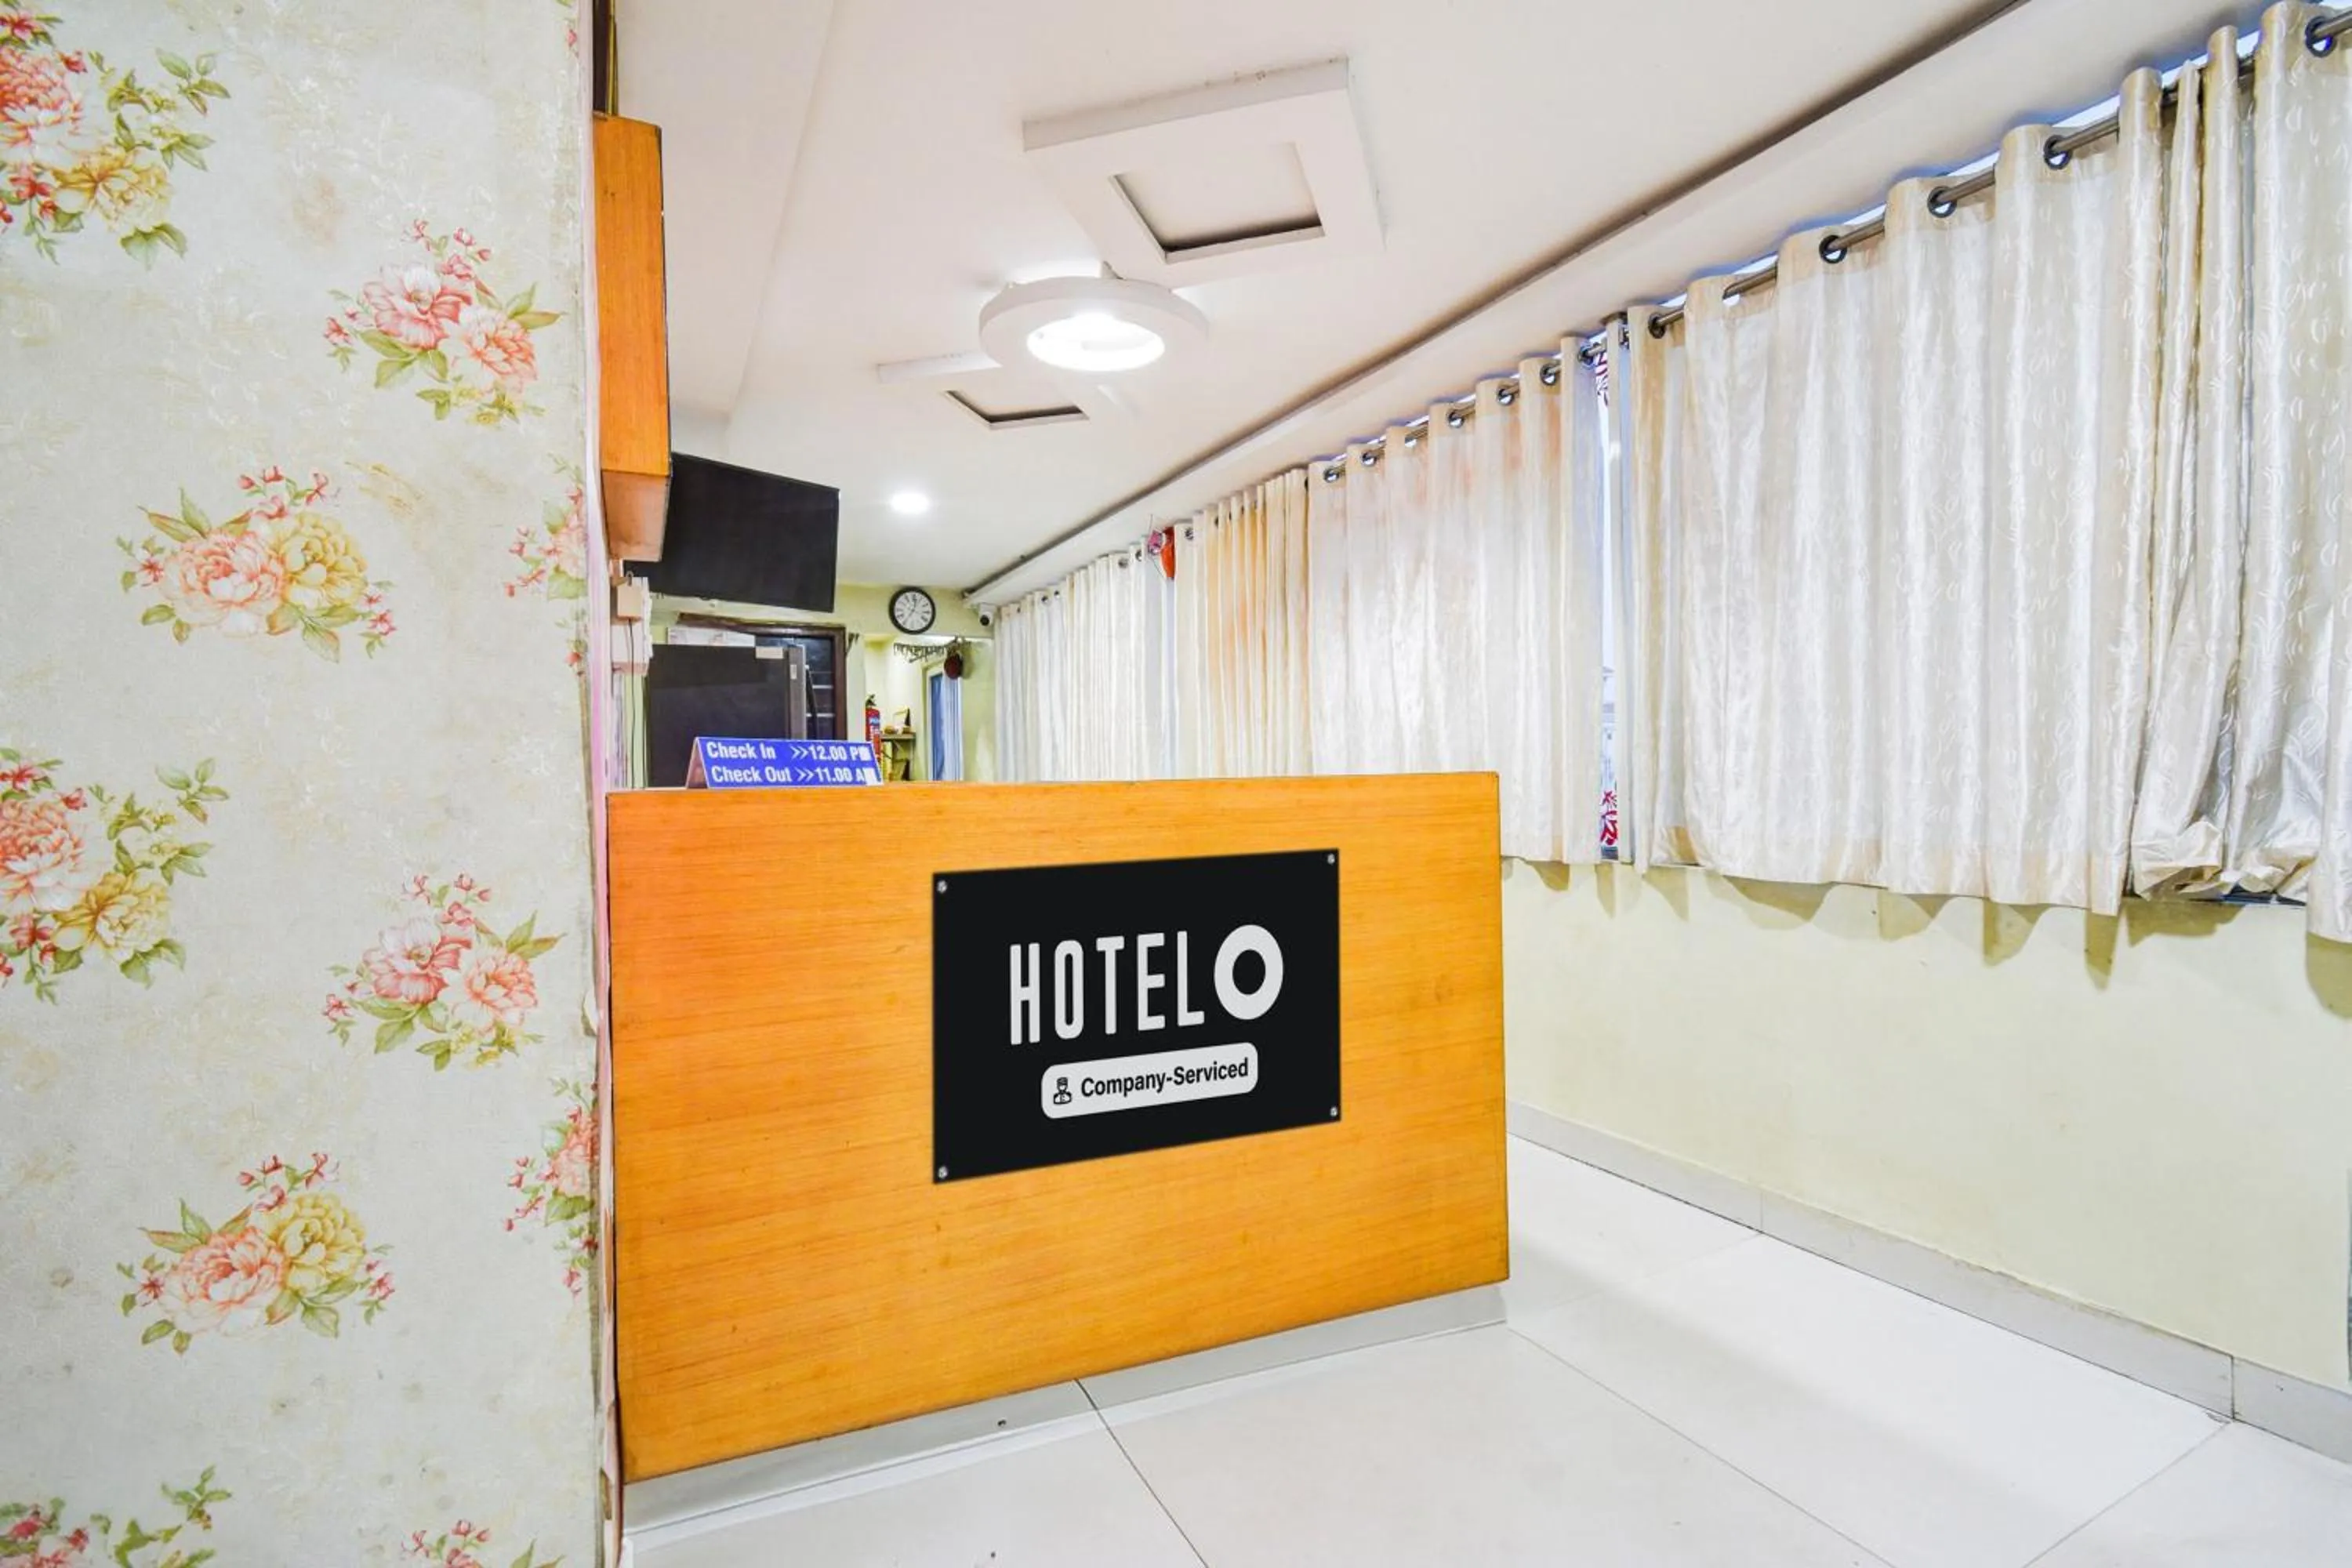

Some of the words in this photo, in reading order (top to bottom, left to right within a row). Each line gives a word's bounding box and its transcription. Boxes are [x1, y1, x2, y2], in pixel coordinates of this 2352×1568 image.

[707, 742, 757, 760] Check
[760, 744, 776, 760] In
[849, 746, 873, 761] P
[711, 765, 762, 783] Check
[764, 767, 792, 782] Out
[855, 768, 879, 785] A
[1010, 931, 1205, 1046] HOTEL
[1080, 1057, 1249, 1098] Company-Serviced
